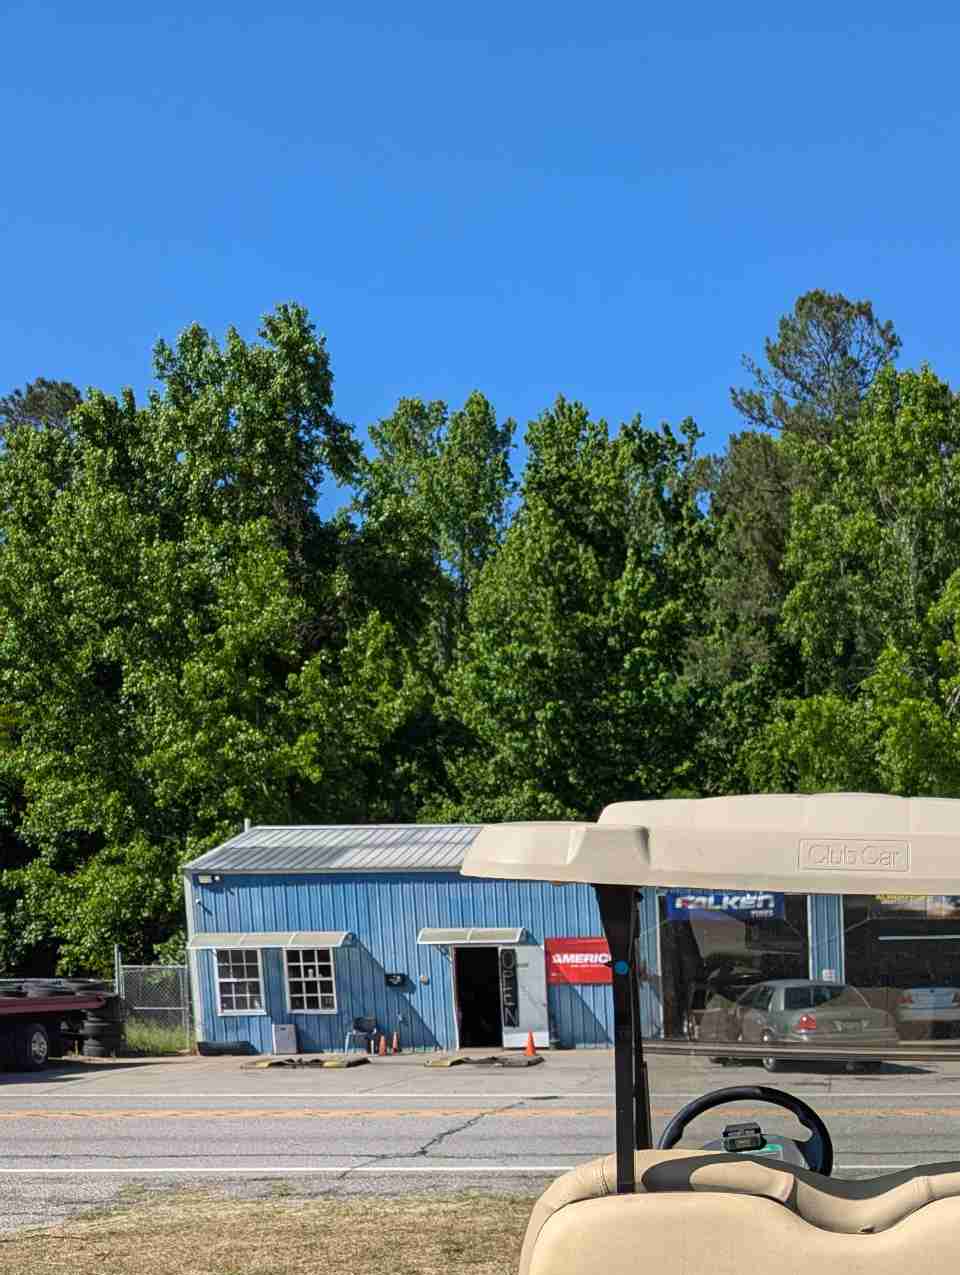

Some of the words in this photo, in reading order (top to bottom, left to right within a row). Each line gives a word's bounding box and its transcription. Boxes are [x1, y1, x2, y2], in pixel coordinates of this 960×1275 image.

[807, 843, 857, 865] Club
[860, 844, 903, 866] Car
[551, 953, 612, 964] AMERIC
